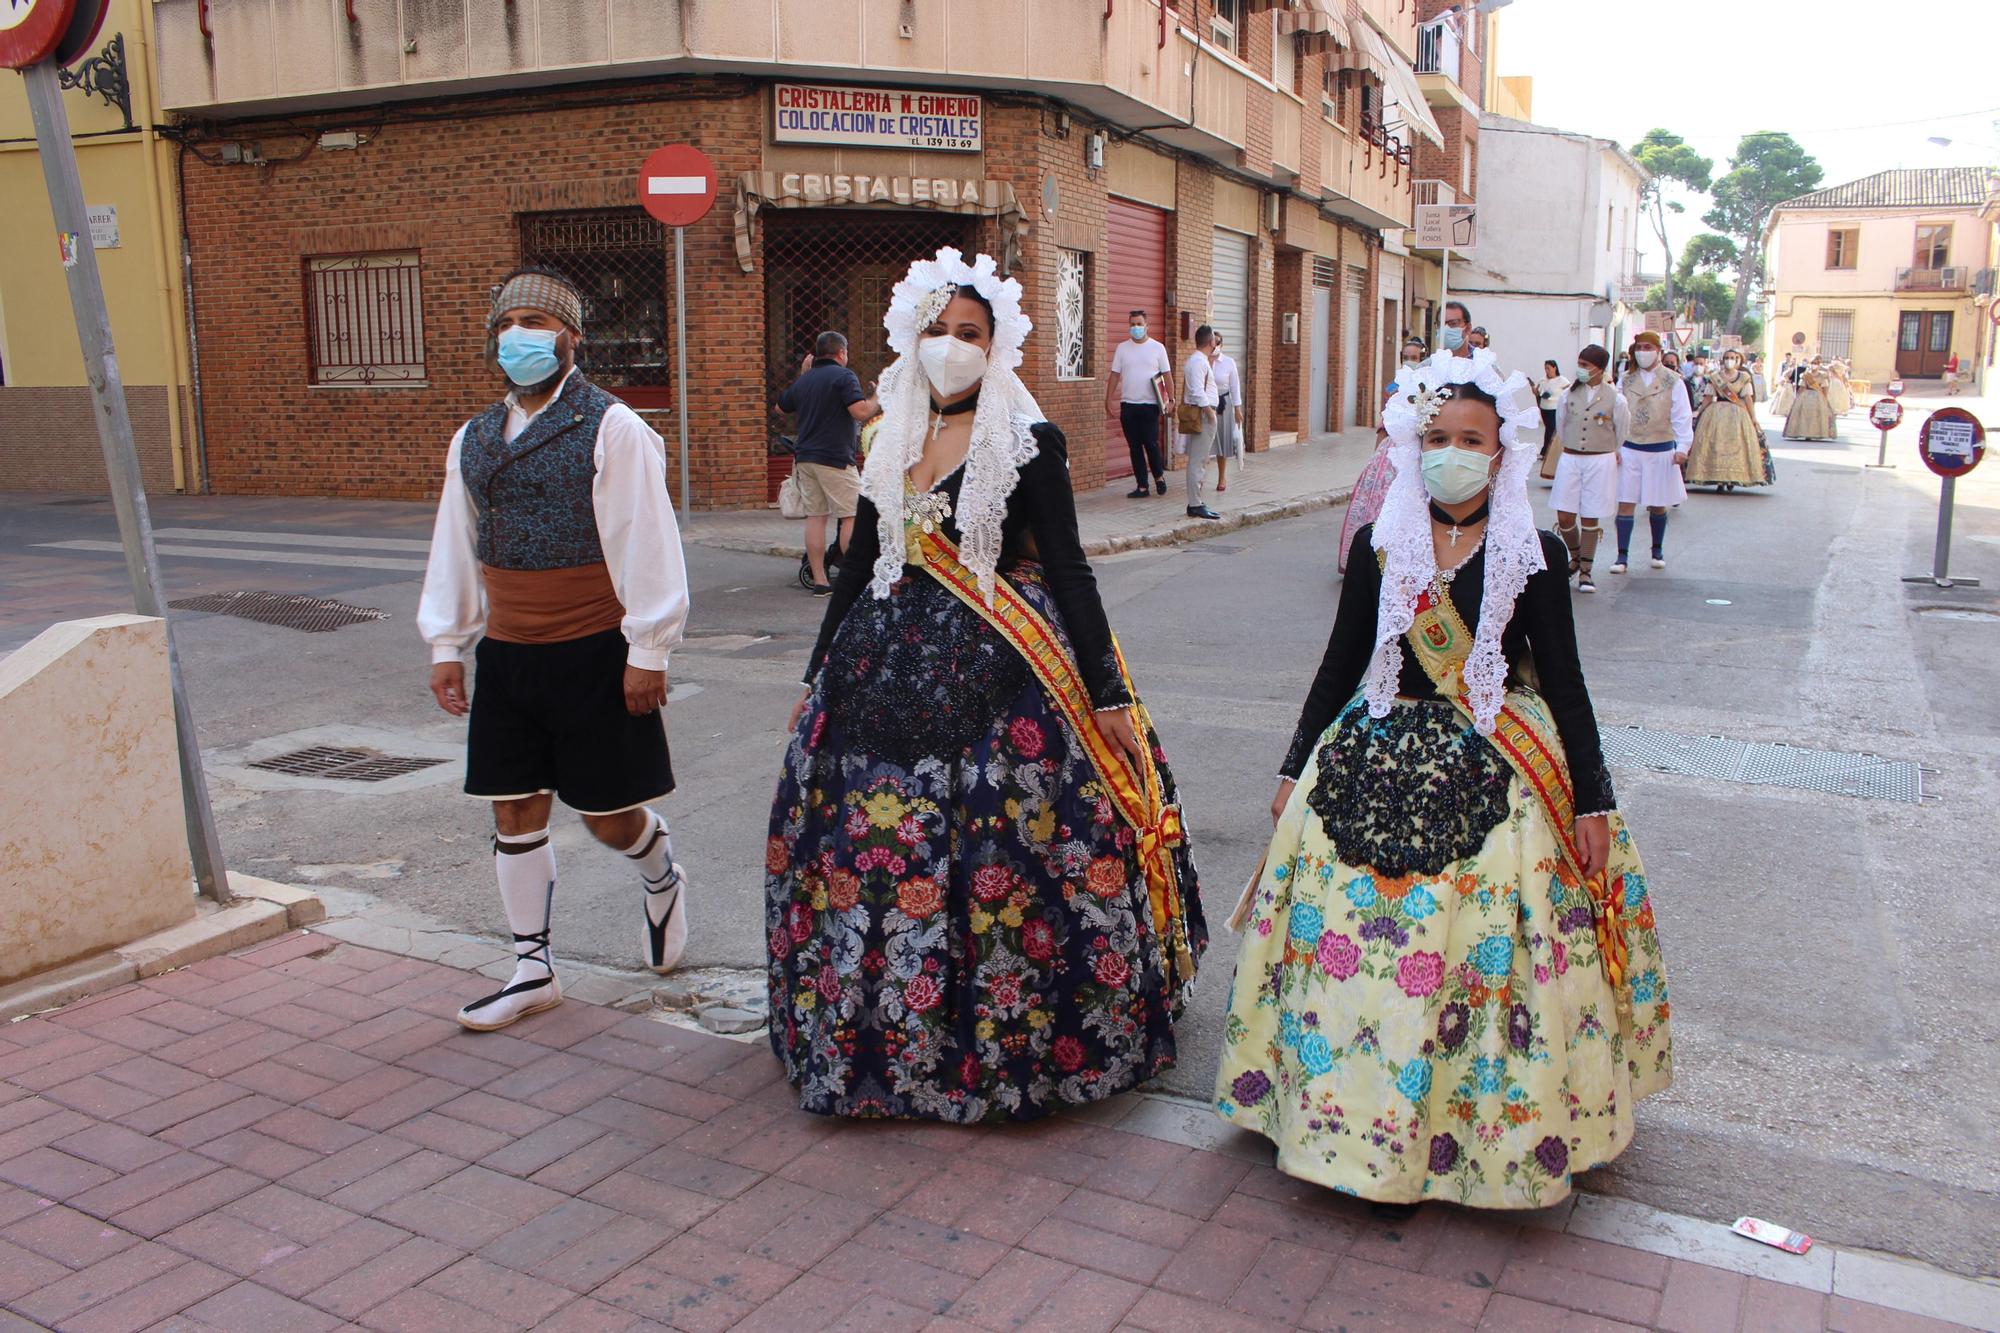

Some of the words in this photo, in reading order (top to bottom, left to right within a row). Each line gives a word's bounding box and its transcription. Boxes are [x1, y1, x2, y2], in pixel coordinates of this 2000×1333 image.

[778, 87, 891, 113] CRISTALERIA
[918, 95, 978, 117] GIMENO
[778, 109, 875, 133] COLOCACION
[880, 118, 896, 134] DE
[899, 116, 978, 138] CRISTALES
[927, 138, 942, 147] 139
[947, 138, 956, 147] 13
[960, 139, 972, 148] 69
[782, 174, 979, 201] CRISTALERIA
[88, 215, 112, 224] ARRER
